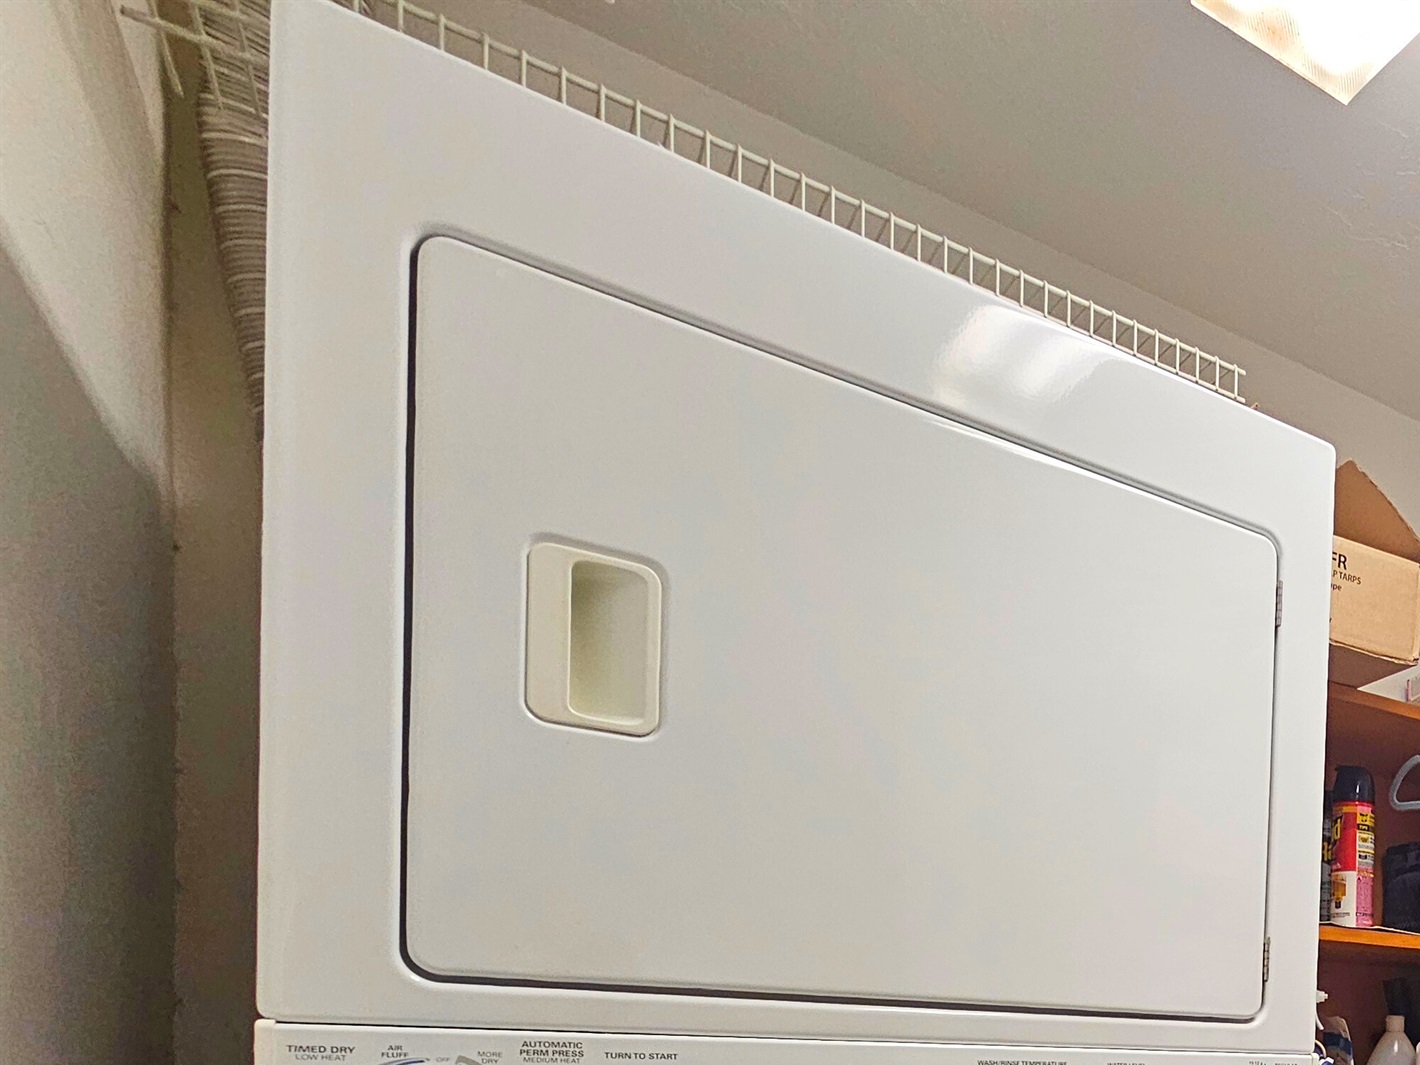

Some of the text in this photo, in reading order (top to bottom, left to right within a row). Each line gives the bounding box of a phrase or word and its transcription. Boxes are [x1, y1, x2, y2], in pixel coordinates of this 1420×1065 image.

[1339, 571, 1362, 585] TARPS
[287, 1044, 356, 1055] TIMED DRY
[521, 1041, 583, 1050] AUTOMATIC
[519, 1049, 585, 1058] PERM PRESS
[604, 1051, 678, 1060] TURN TO START
